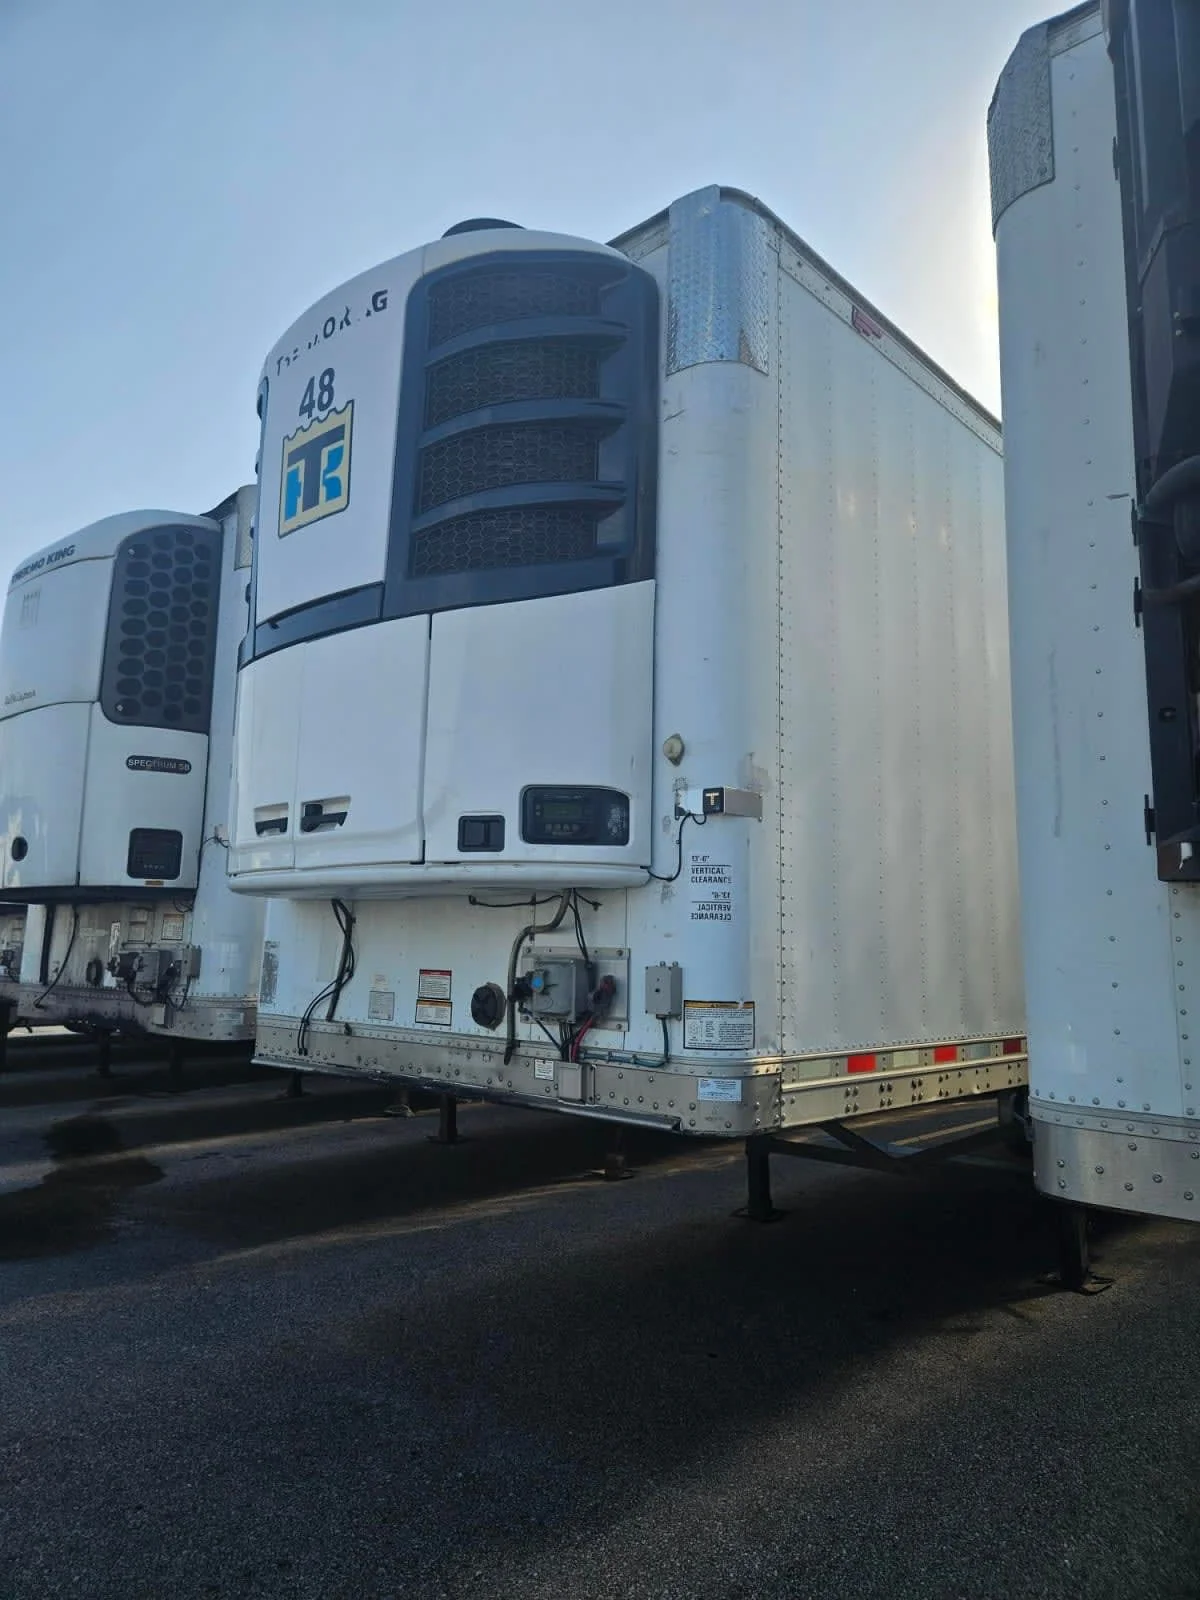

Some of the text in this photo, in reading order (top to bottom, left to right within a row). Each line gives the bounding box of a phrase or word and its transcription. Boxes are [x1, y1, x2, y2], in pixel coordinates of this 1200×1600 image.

[298, 367, 335, 419] 48
[47, 544, 76, 565] KING
[691, 867, 725, 875] VERTICAL
